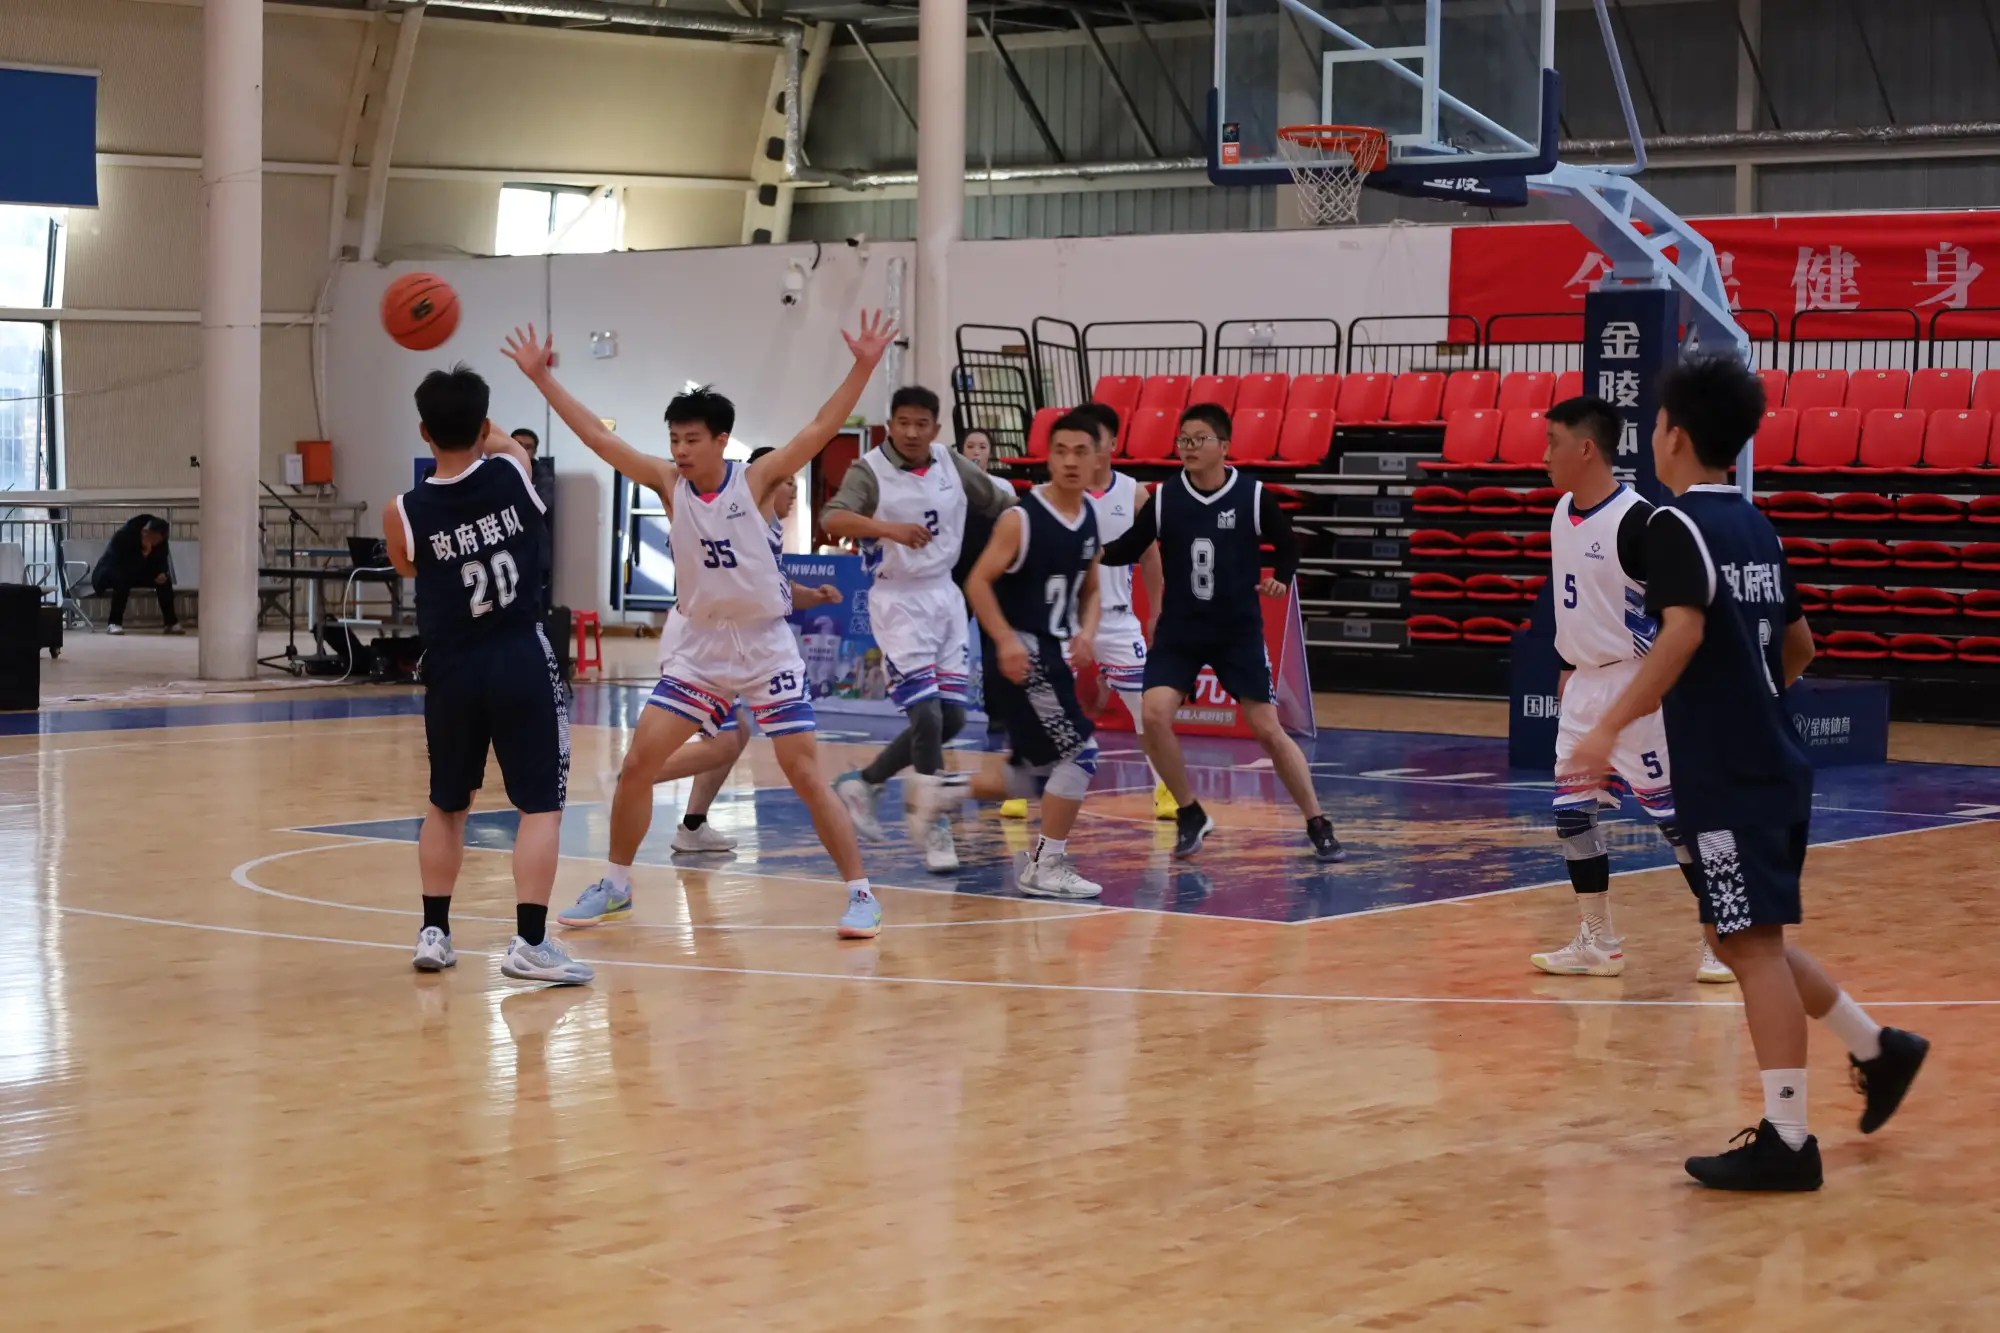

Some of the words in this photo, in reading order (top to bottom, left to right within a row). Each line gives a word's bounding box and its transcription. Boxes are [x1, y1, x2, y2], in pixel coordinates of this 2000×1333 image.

[429, 505, 524, 561] 政府联队
[924, 509, 939, 536] 2
[700, 539, 738, 568] 35
[1191, 538, 1214, 600] 8
[461, 550, 519, 618] 20
[1564, 574, 1577, 609] 5
[769, 671, 796, 695] 35
[1810, 716, 1851, 737] 金陵体育
[1641, 751, 1663, 779] 5
